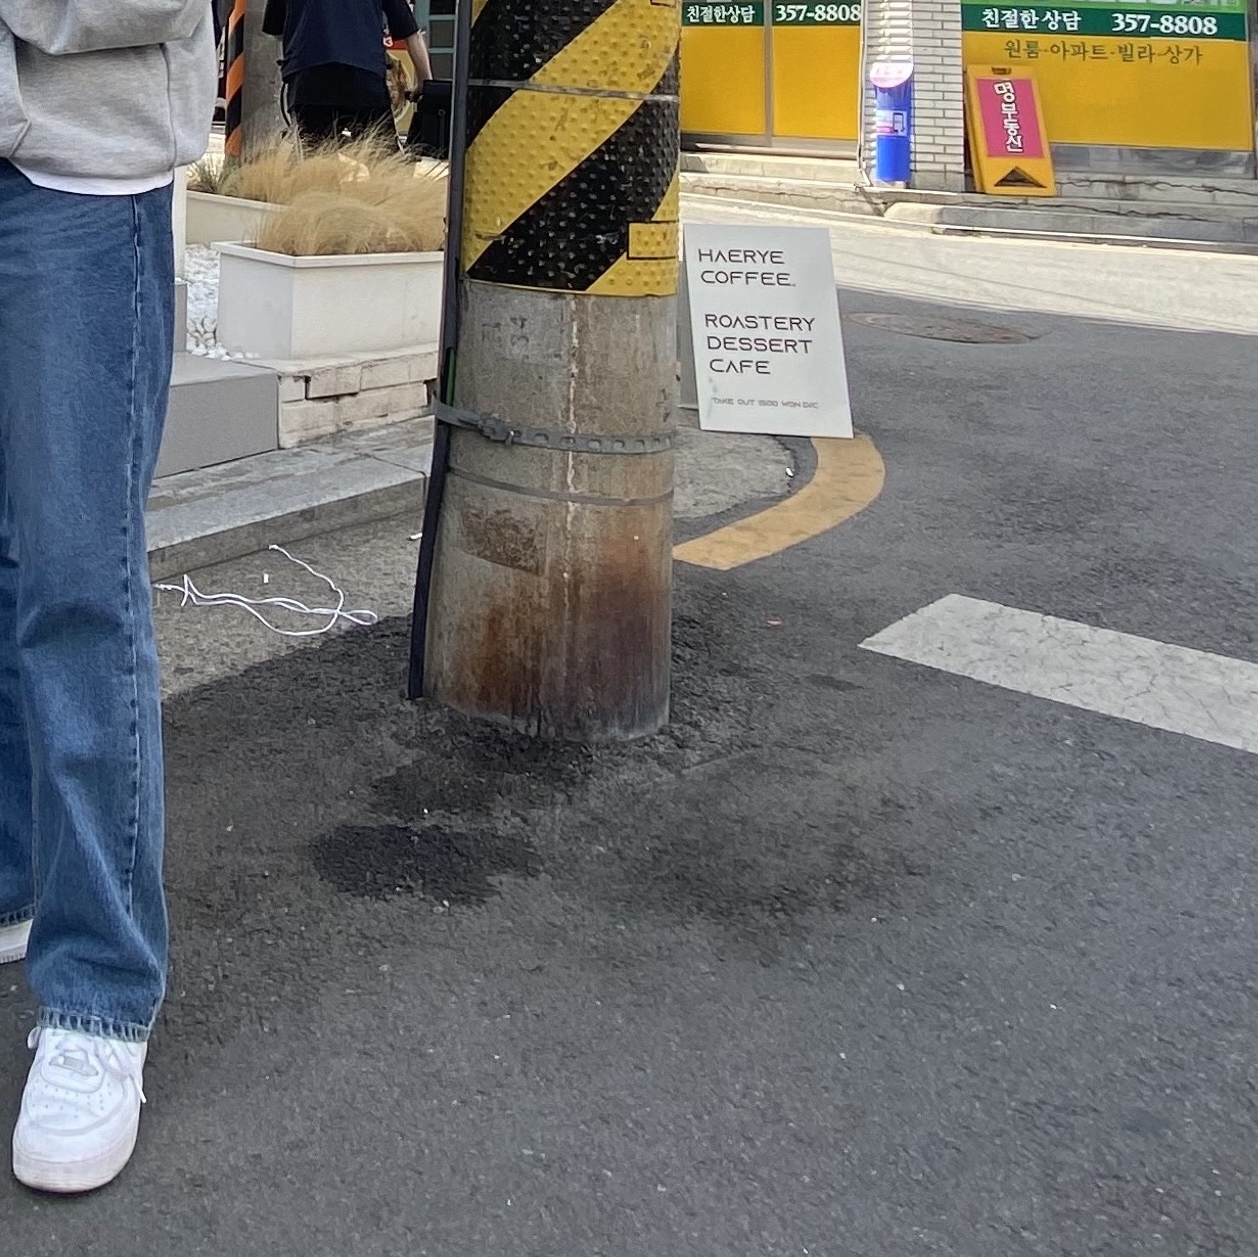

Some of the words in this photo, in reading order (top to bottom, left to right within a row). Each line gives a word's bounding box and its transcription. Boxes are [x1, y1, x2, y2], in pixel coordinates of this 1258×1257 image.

[775, 4, 862, 22] 357-8808
[1112, 13, 1218, 36] 357-8808
[698, 248, 786, 265] HAERYE
[704, 313, 816, 332] ROASTERY
[706, 335, 813, 354] DESSERT
[709, 358, 771, 375] CAFE
